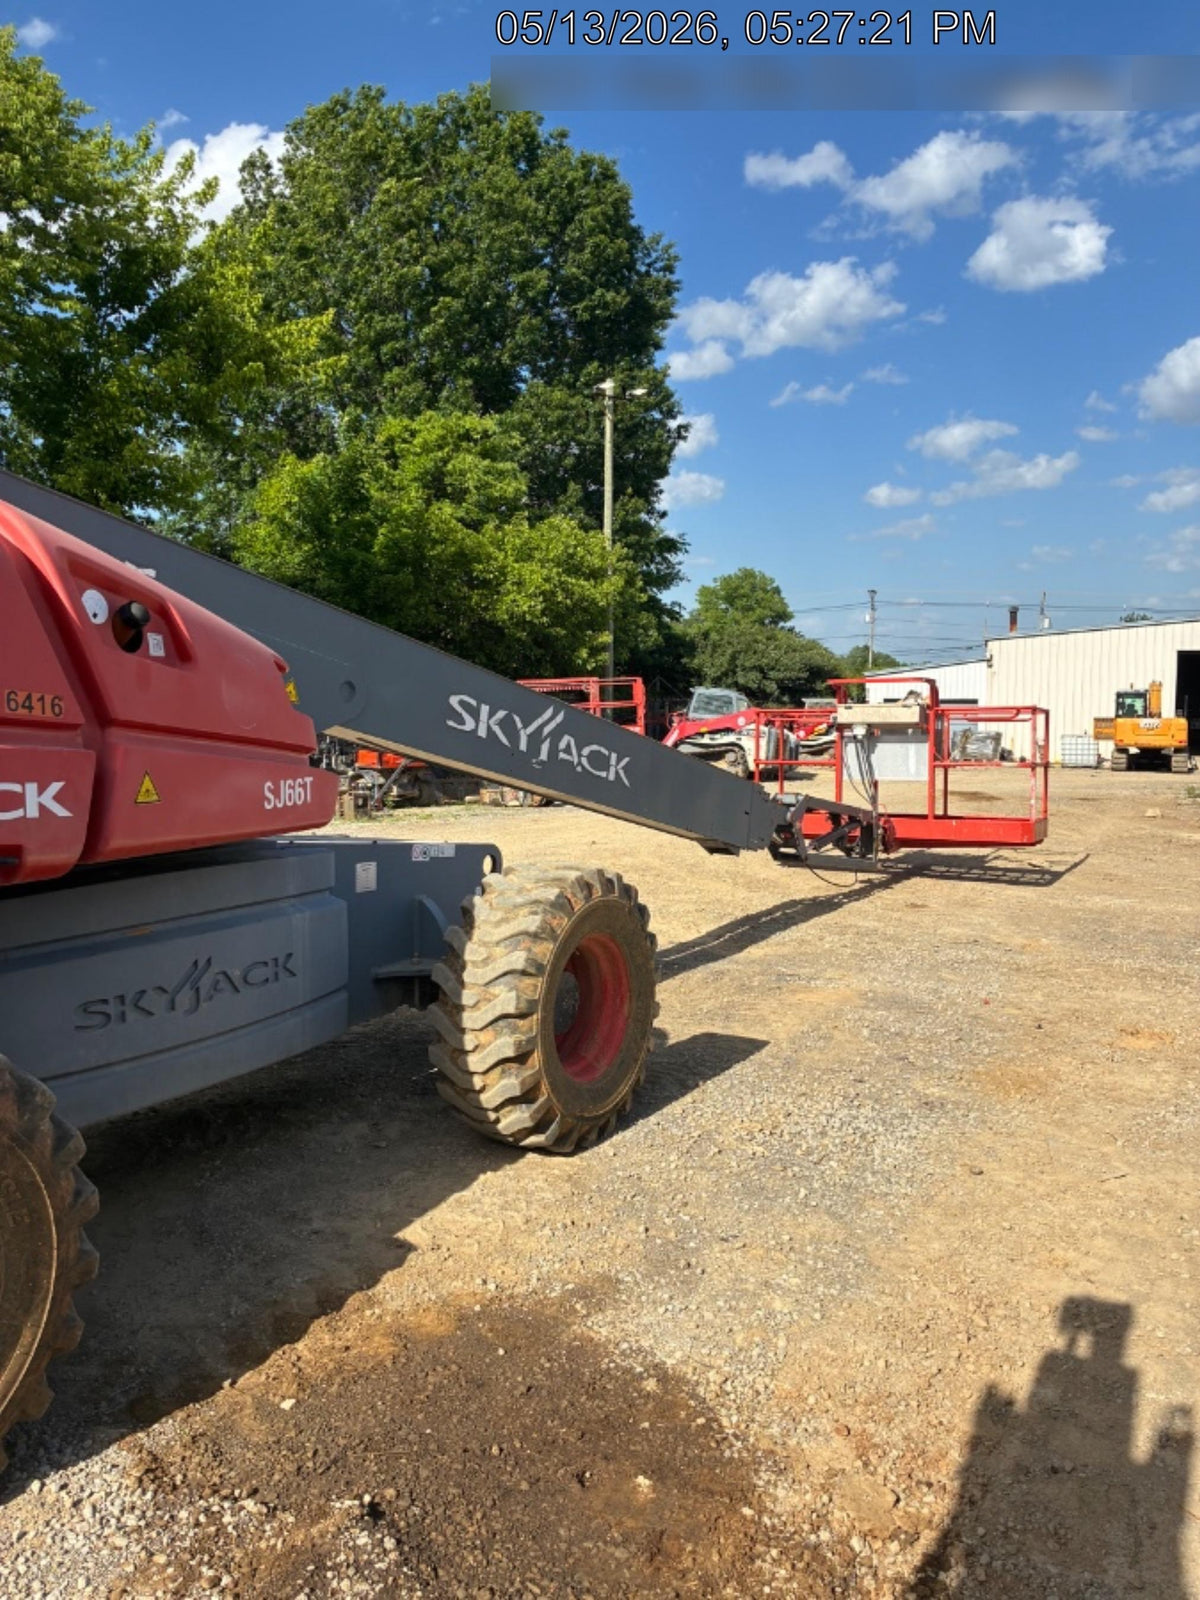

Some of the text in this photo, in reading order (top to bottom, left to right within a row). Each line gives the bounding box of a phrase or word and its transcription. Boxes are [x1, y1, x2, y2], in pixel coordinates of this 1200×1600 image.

[6, 690, 64, 717] 6416
[446, 694, 631, 788] SKYJACK
[264, 776, 314, 810] SJ66T
[74, 952, 298, 1031] SKYJACK
